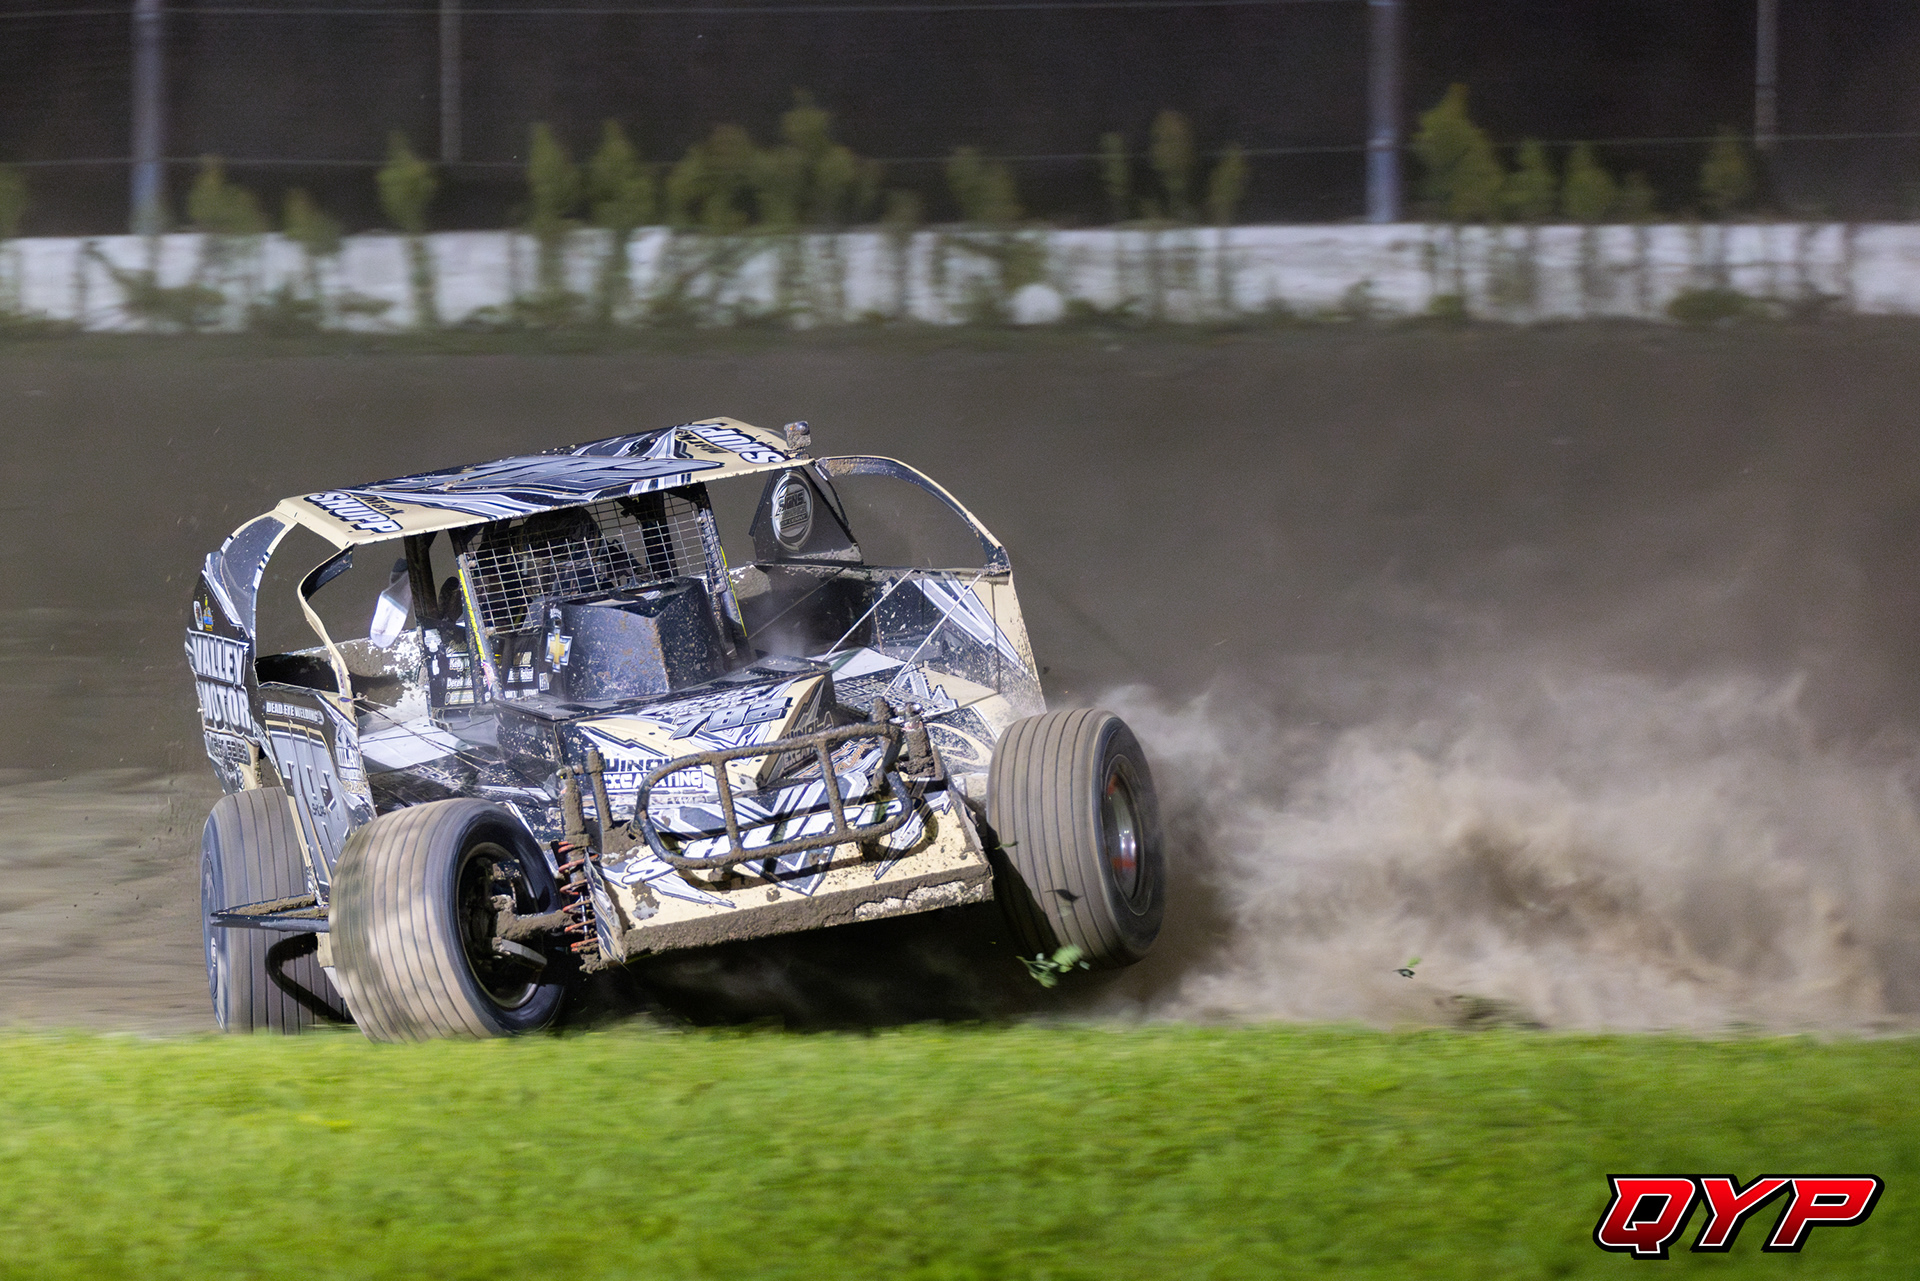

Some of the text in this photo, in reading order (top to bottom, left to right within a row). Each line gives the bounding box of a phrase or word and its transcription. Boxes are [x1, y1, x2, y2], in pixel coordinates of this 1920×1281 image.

[303, 491, 403, 533] SHUPP
[189, 633, 246, 686] VALLEY
[199, 680, 253, 733] MOTOR
